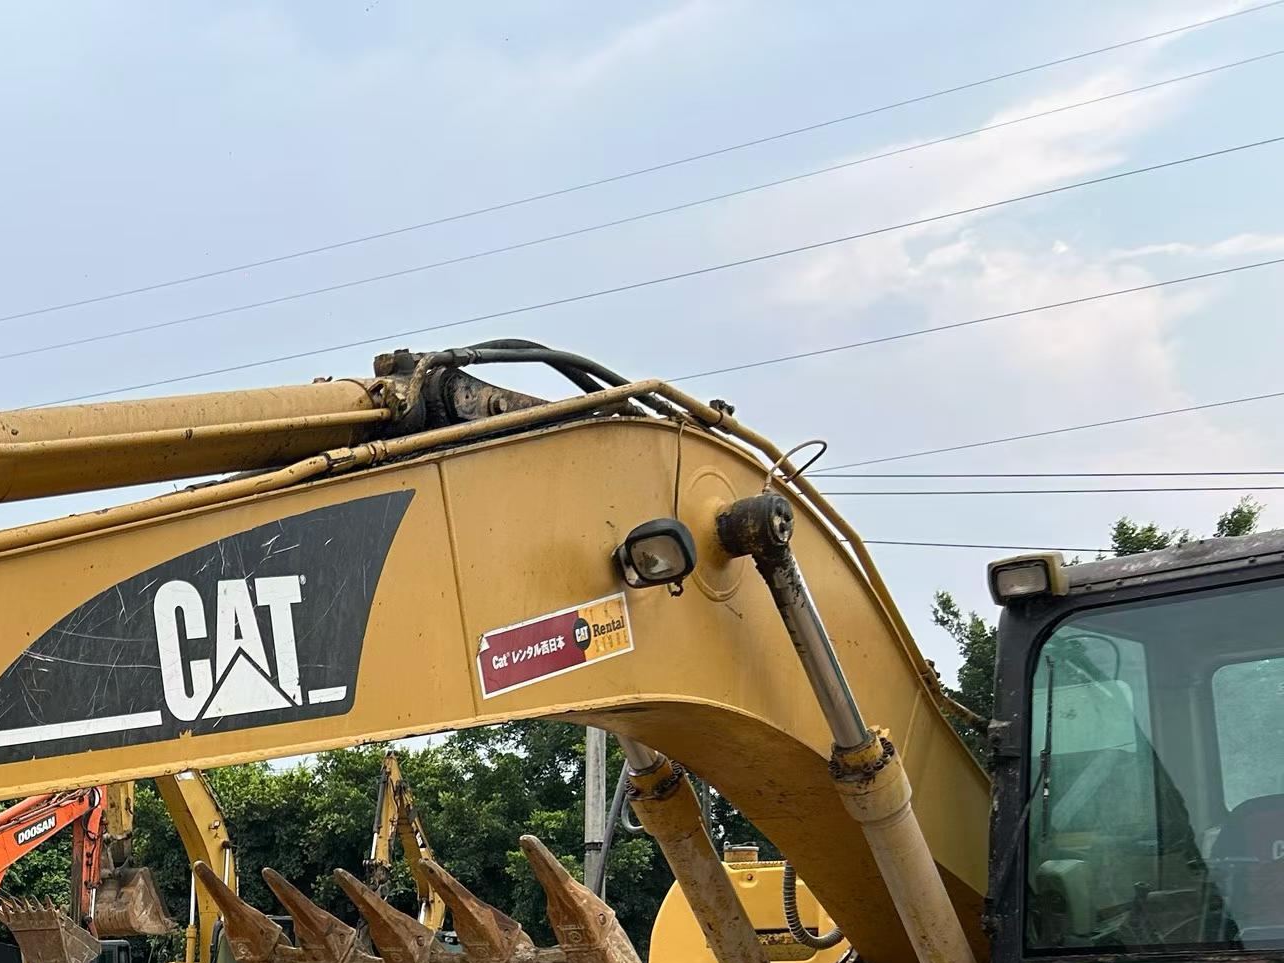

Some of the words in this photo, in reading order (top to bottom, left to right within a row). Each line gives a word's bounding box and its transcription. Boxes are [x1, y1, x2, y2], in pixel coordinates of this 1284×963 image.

[574, 625, 589, 643] CAT
[592, 615, 625, 638] Rental
[154, 575, 303, 722] CAT
[512, 635, 566, 664] レンタル西日本
[17, 816, 56, 845] DOOSAN
